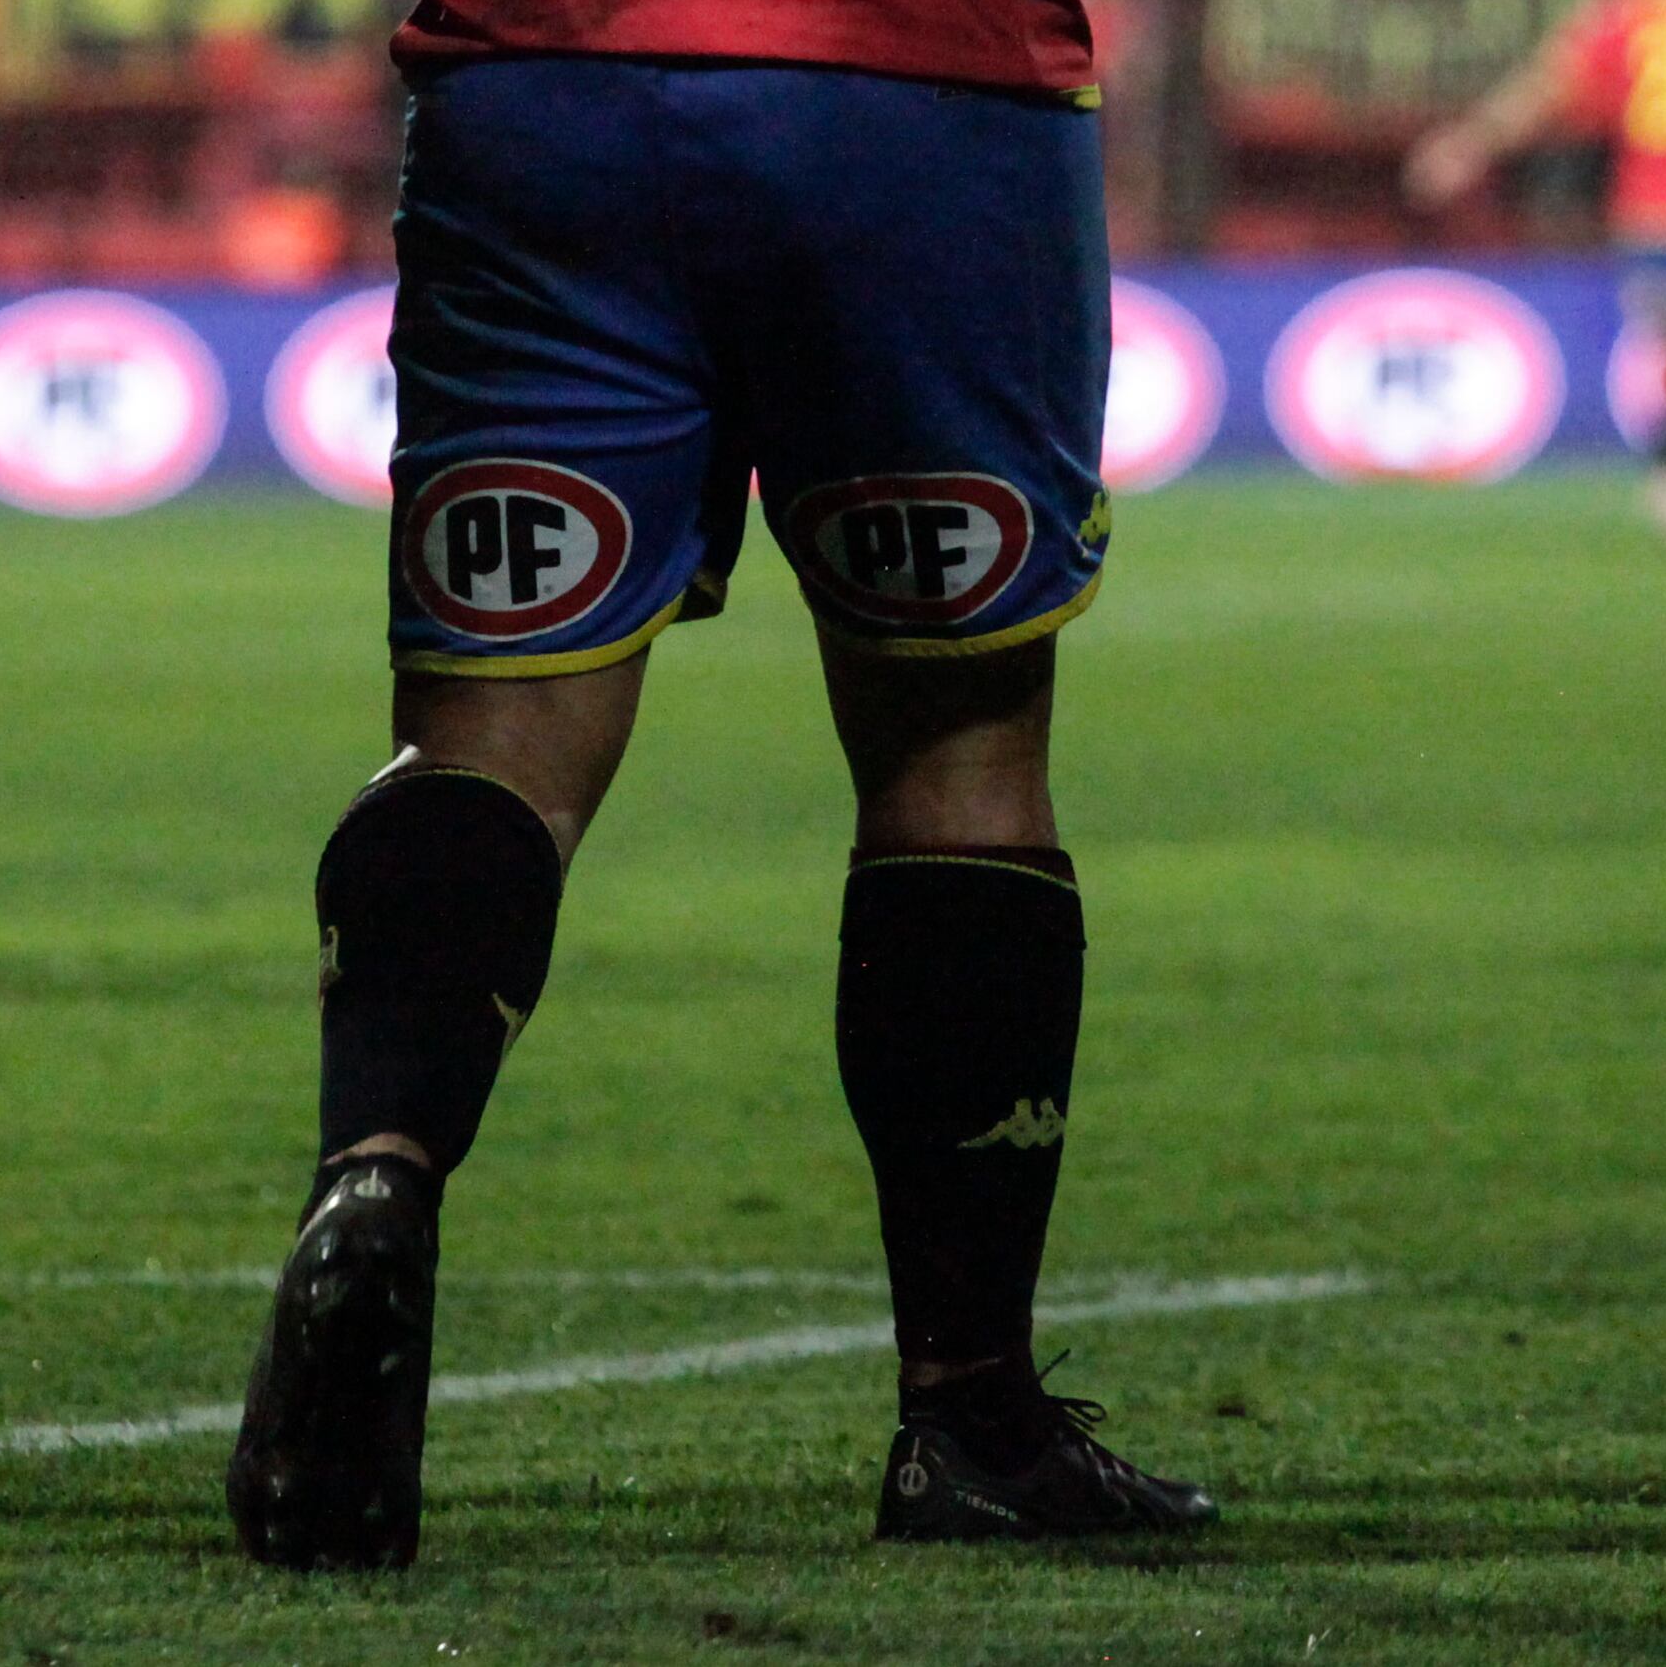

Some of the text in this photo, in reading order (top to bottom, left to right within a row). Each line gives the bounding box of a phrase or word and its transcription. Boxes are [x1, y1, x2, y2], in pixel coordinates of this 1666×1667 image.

[445, 494, 567, 606] PF
[839, 503, 970, 599] PF
[954, 1488, 1020, 1525] TIEMPO
